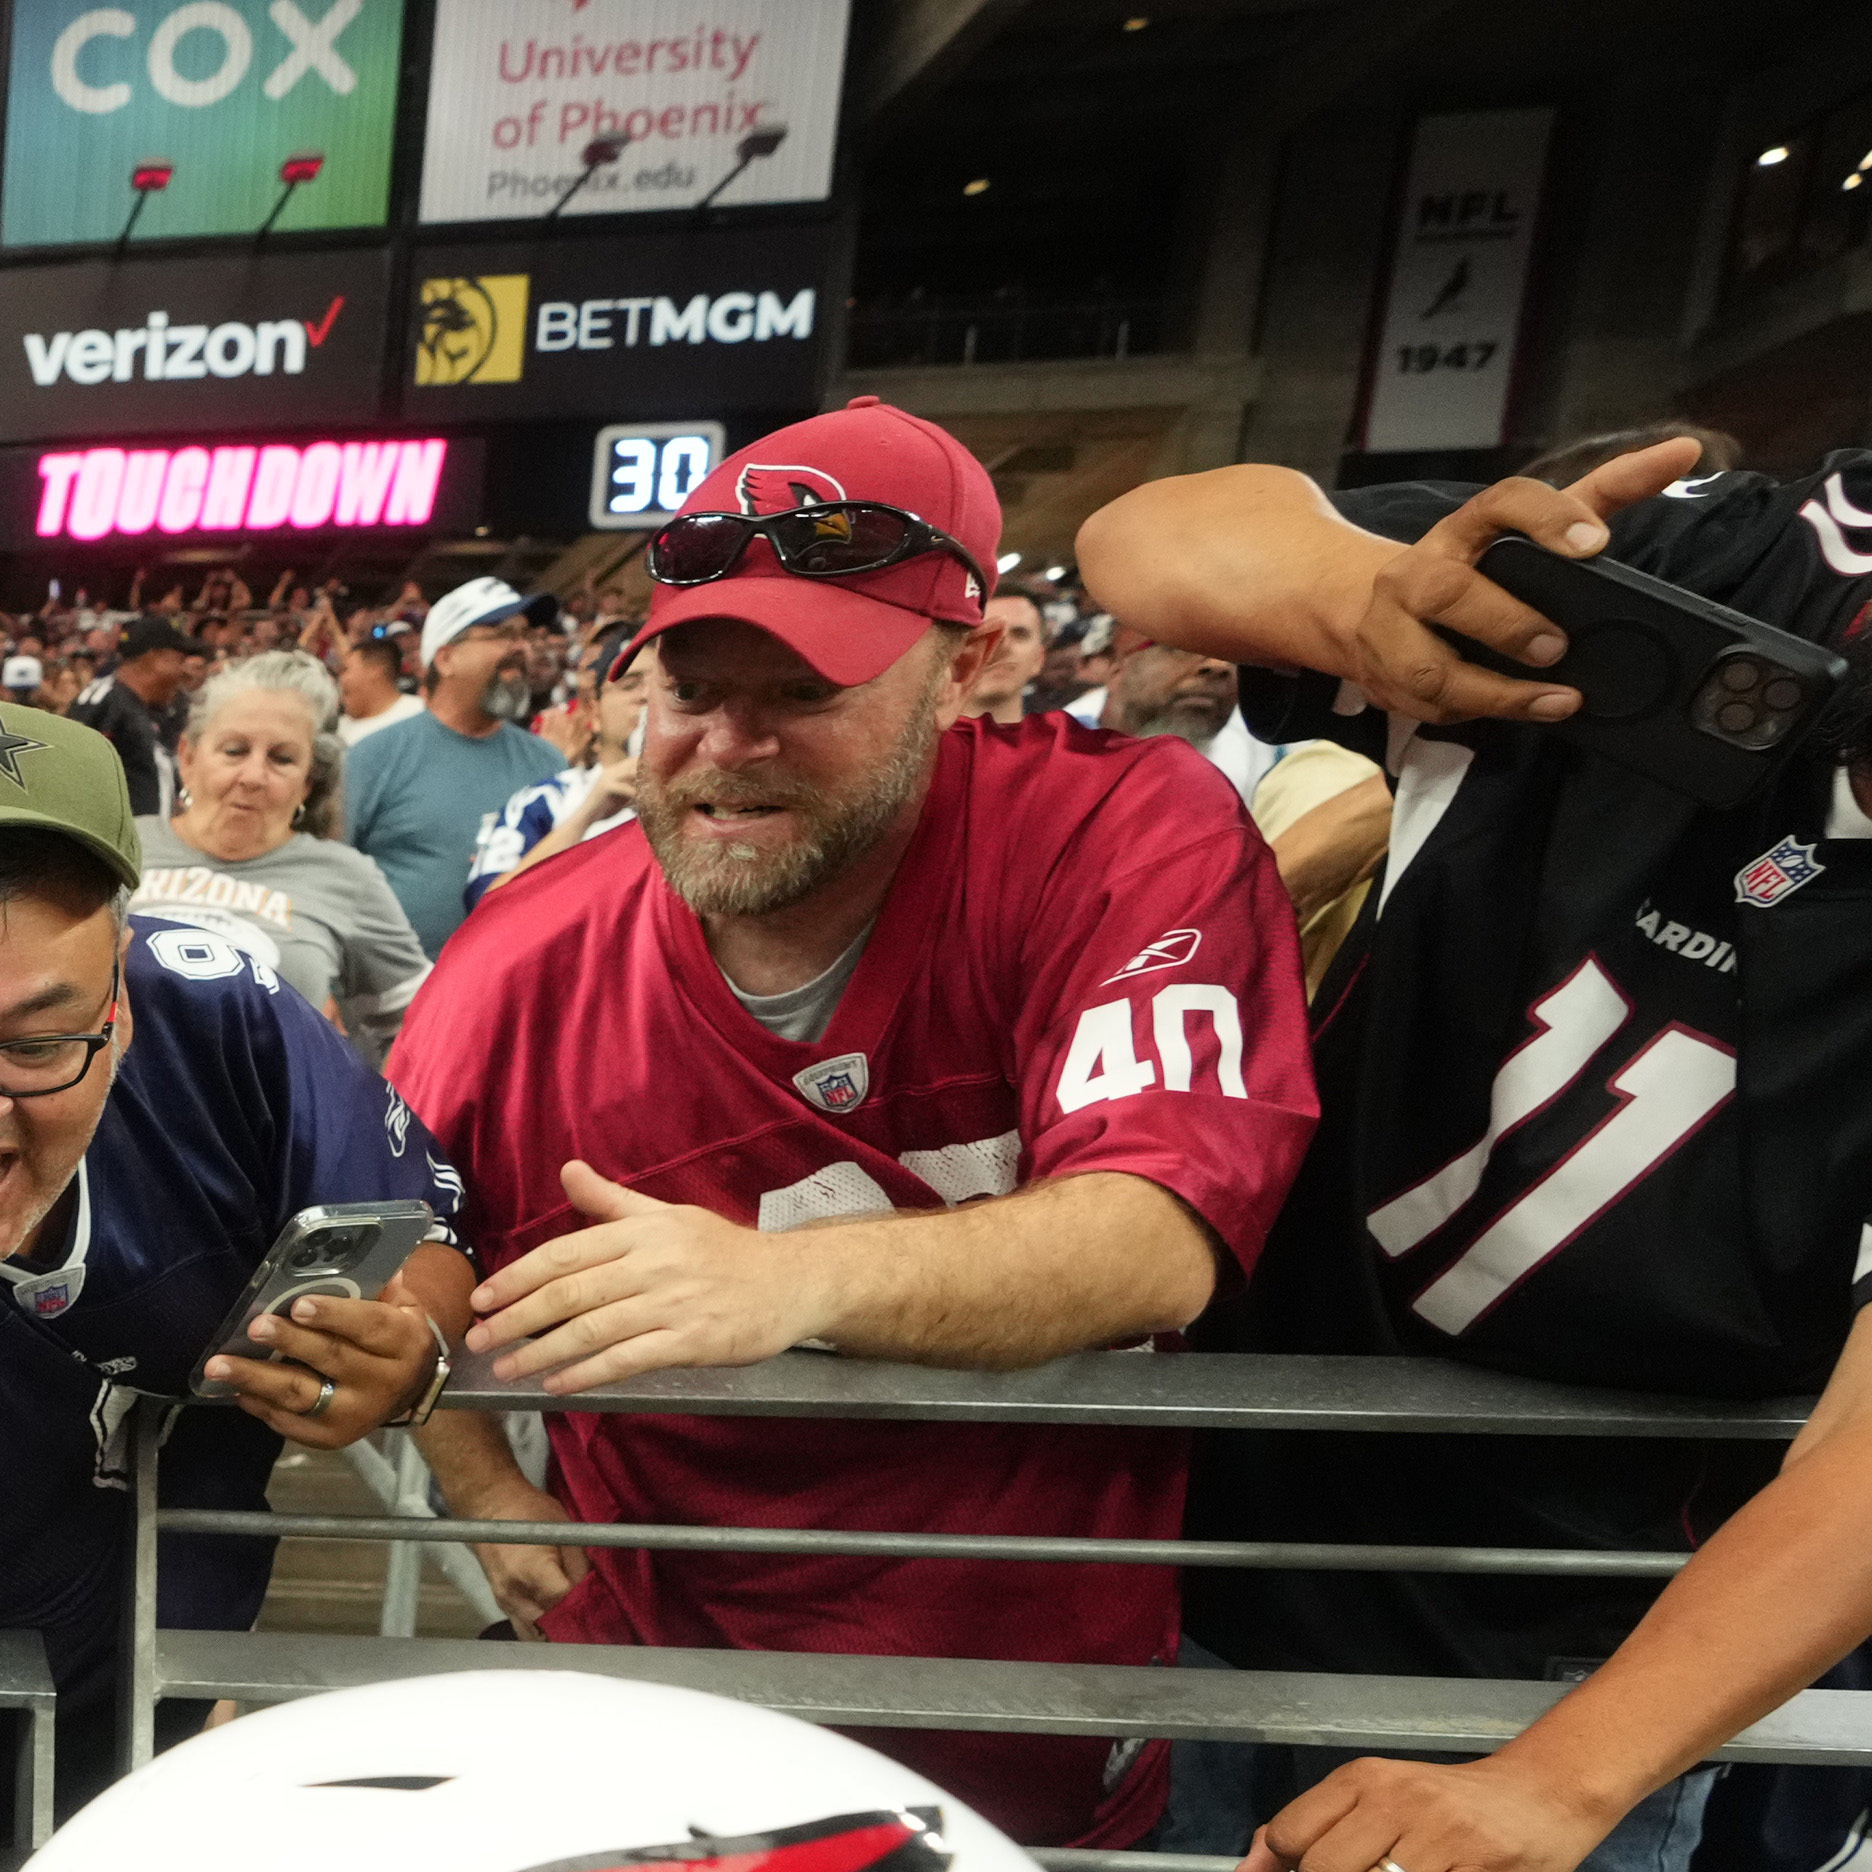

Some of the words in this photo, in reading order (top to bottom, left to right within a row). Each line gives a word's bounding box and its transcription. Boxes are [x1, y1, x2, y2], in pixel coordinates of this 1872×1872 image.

[52, 0, 362, 114] COX
[499, 27, 763, 86] University
[492, 103, 545, 149] of
[559, 97, 768, 146] Phoenix
[486, 162, 696, 200] Phoenix.edu
[24, 313, 306, 388] verizon
[537, 290, 816, 353] BETMGM
[35, 437, 449, 541] TOUCHDOWN
[608, 434, 718, 516] 30
[130, 866, 293, 932] RIZONA
[1635, 897, 1739, 977] ARDI
[1055, 983, 1251, 1115] 40
[1366, 953, 1738, 1337] 11
